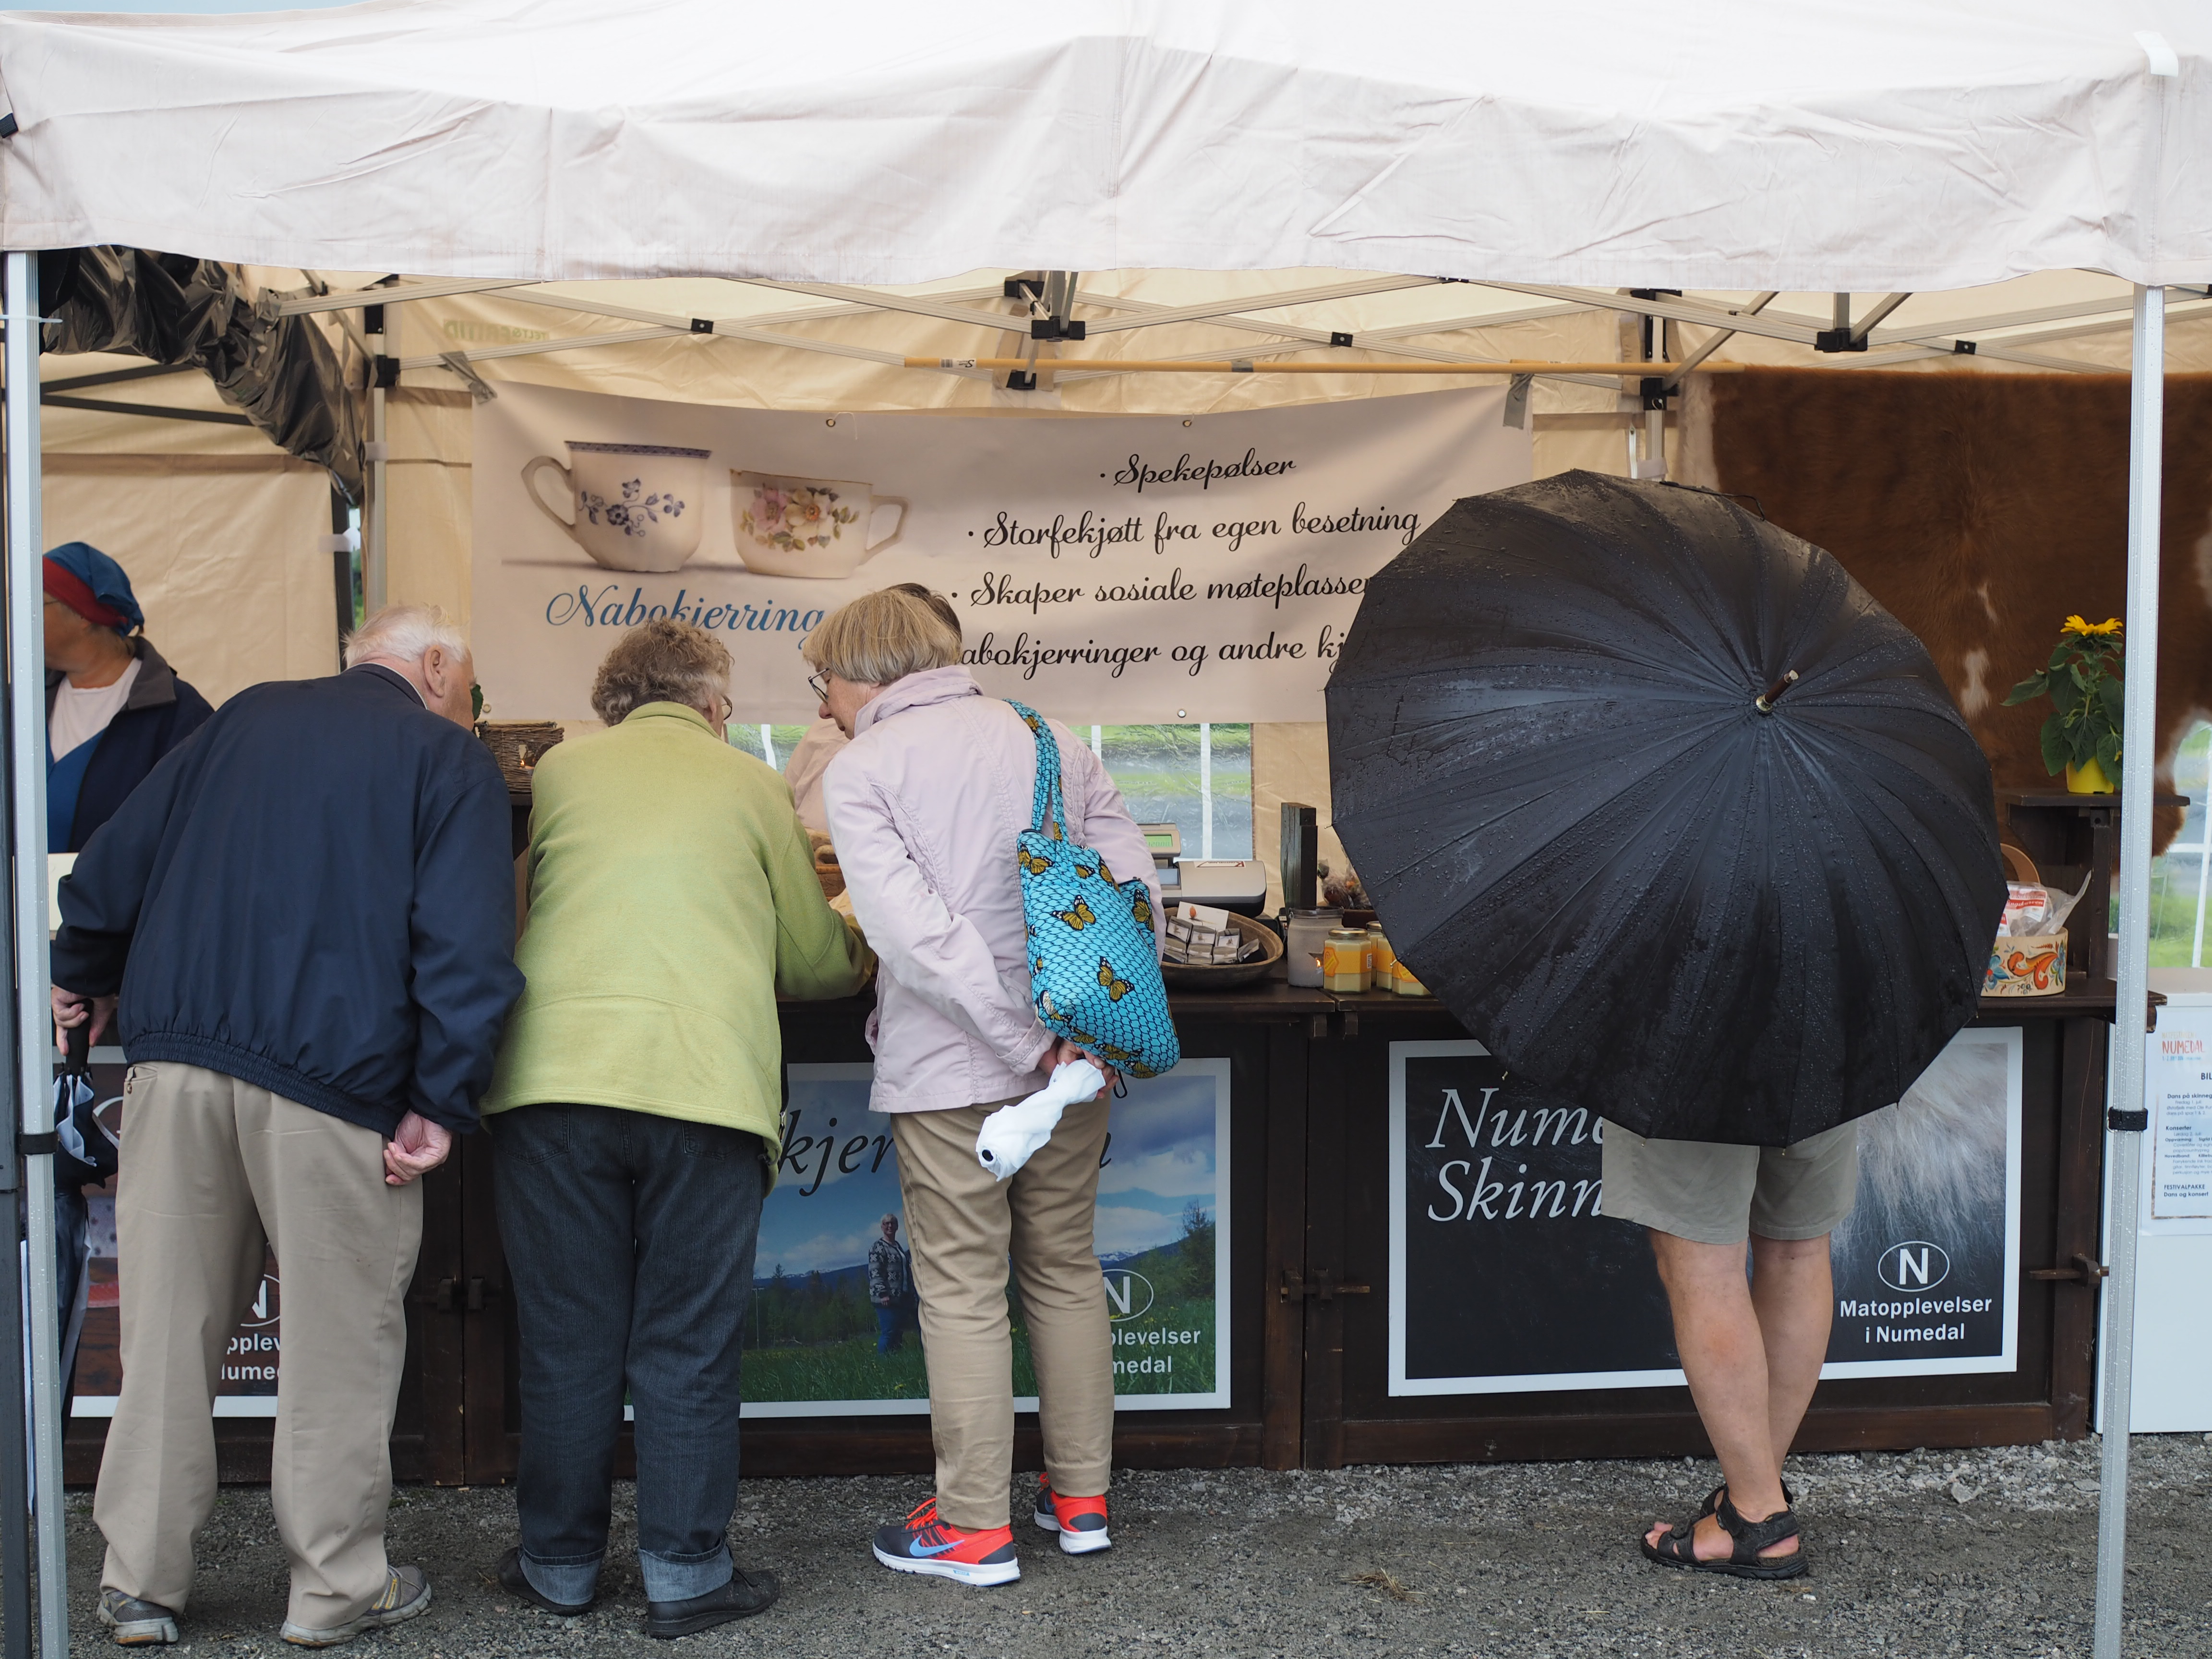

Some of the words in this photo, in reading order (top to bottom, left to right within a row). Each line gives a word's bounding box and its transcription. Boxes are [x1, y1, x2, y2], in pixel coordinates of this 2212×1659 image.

[1114, 447, 1296, 493] Spekepølser
[984, 510, 1144, 559] Storfekjøtt
[1154, 511, 1202, 555] fra
[1212, 519, 1281, 552] egen
[1292, 502, 1421, 546] besetning
[971, 572, 1085, 614] Skaper
[1095, 567, 1197, 601] sosiale
[546, 584, 825, 650] Nabokjerring
[961, 632, 1162, 680] abokjerringer
[1171, 645, 1209, 676] og
[1219, 631, 1307, 660] andre
[1317, 625, 1345, 675] kj
[2162, 1040, 2206, 1054] NUMEDAL
[2201, 1072, 2212, 1080] BIL
[1425, 1087, 1603, 1148] Nume
[1428, 1156, 1603, 1222] Skinn
[1899, 1248, 1928, 1285] N
[1840, 1296, 1992, 1319] Matopplevelser
[1111, 1327, 1201, 1346] levelser
[1865, 1327, 1870, 1343] i
[1876, 1323, 1964, 1343] Numedal
[1112, 1355, 1172, 1374] medal
